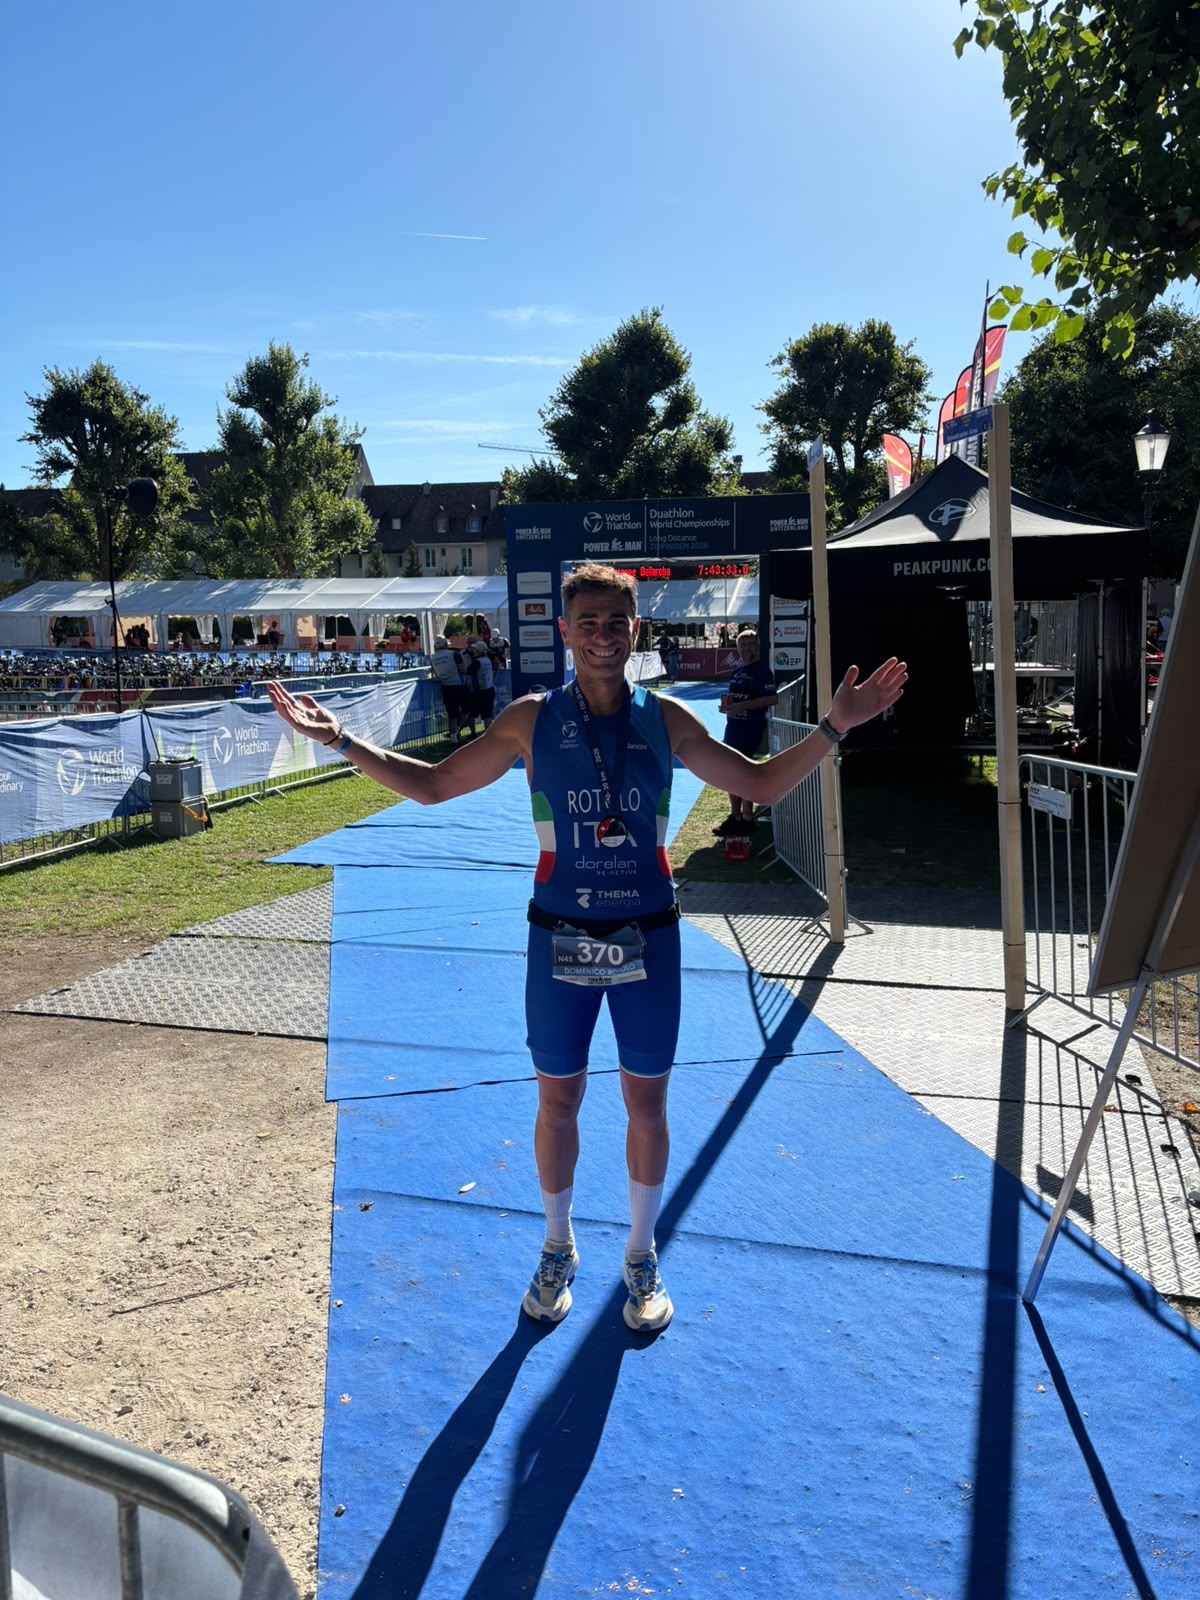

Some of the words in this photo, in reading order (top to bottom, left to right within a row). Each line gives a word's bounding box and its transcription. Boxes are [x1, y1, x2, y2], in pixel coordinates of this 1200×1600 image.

[605, 512, 631, 521] World
[650, 508, 694, 518] Duathlon
[605, 520, 642, 530] Triathlon
[650, 520, 673, 529] World
[673, 518, 730, 529] Championships
[650, 535, 667, 543] Long
[667, 534, 697, 542] Distance
[583, 542, 610, 552] POWER
[625, 541, 642, 551] MAN
[234, 725, 258, 742] World
[235, 738, 270, 757] Triathlon
[89, 745, 124, 764] World
[0, 772, 12, 782] our
[91, 765, 138, 786] Triathlon
[0, 780, 24, 793] dinary
[567, 787, 641, 814] ROTLO
[575, 855, 637, 869] dorelan
[596, 889, 640, 898] THEMA
[596, 898, 641, 908] energia
[577, 942, 624, 966] 370
[564, 967, 606, 976] DOMENICO
